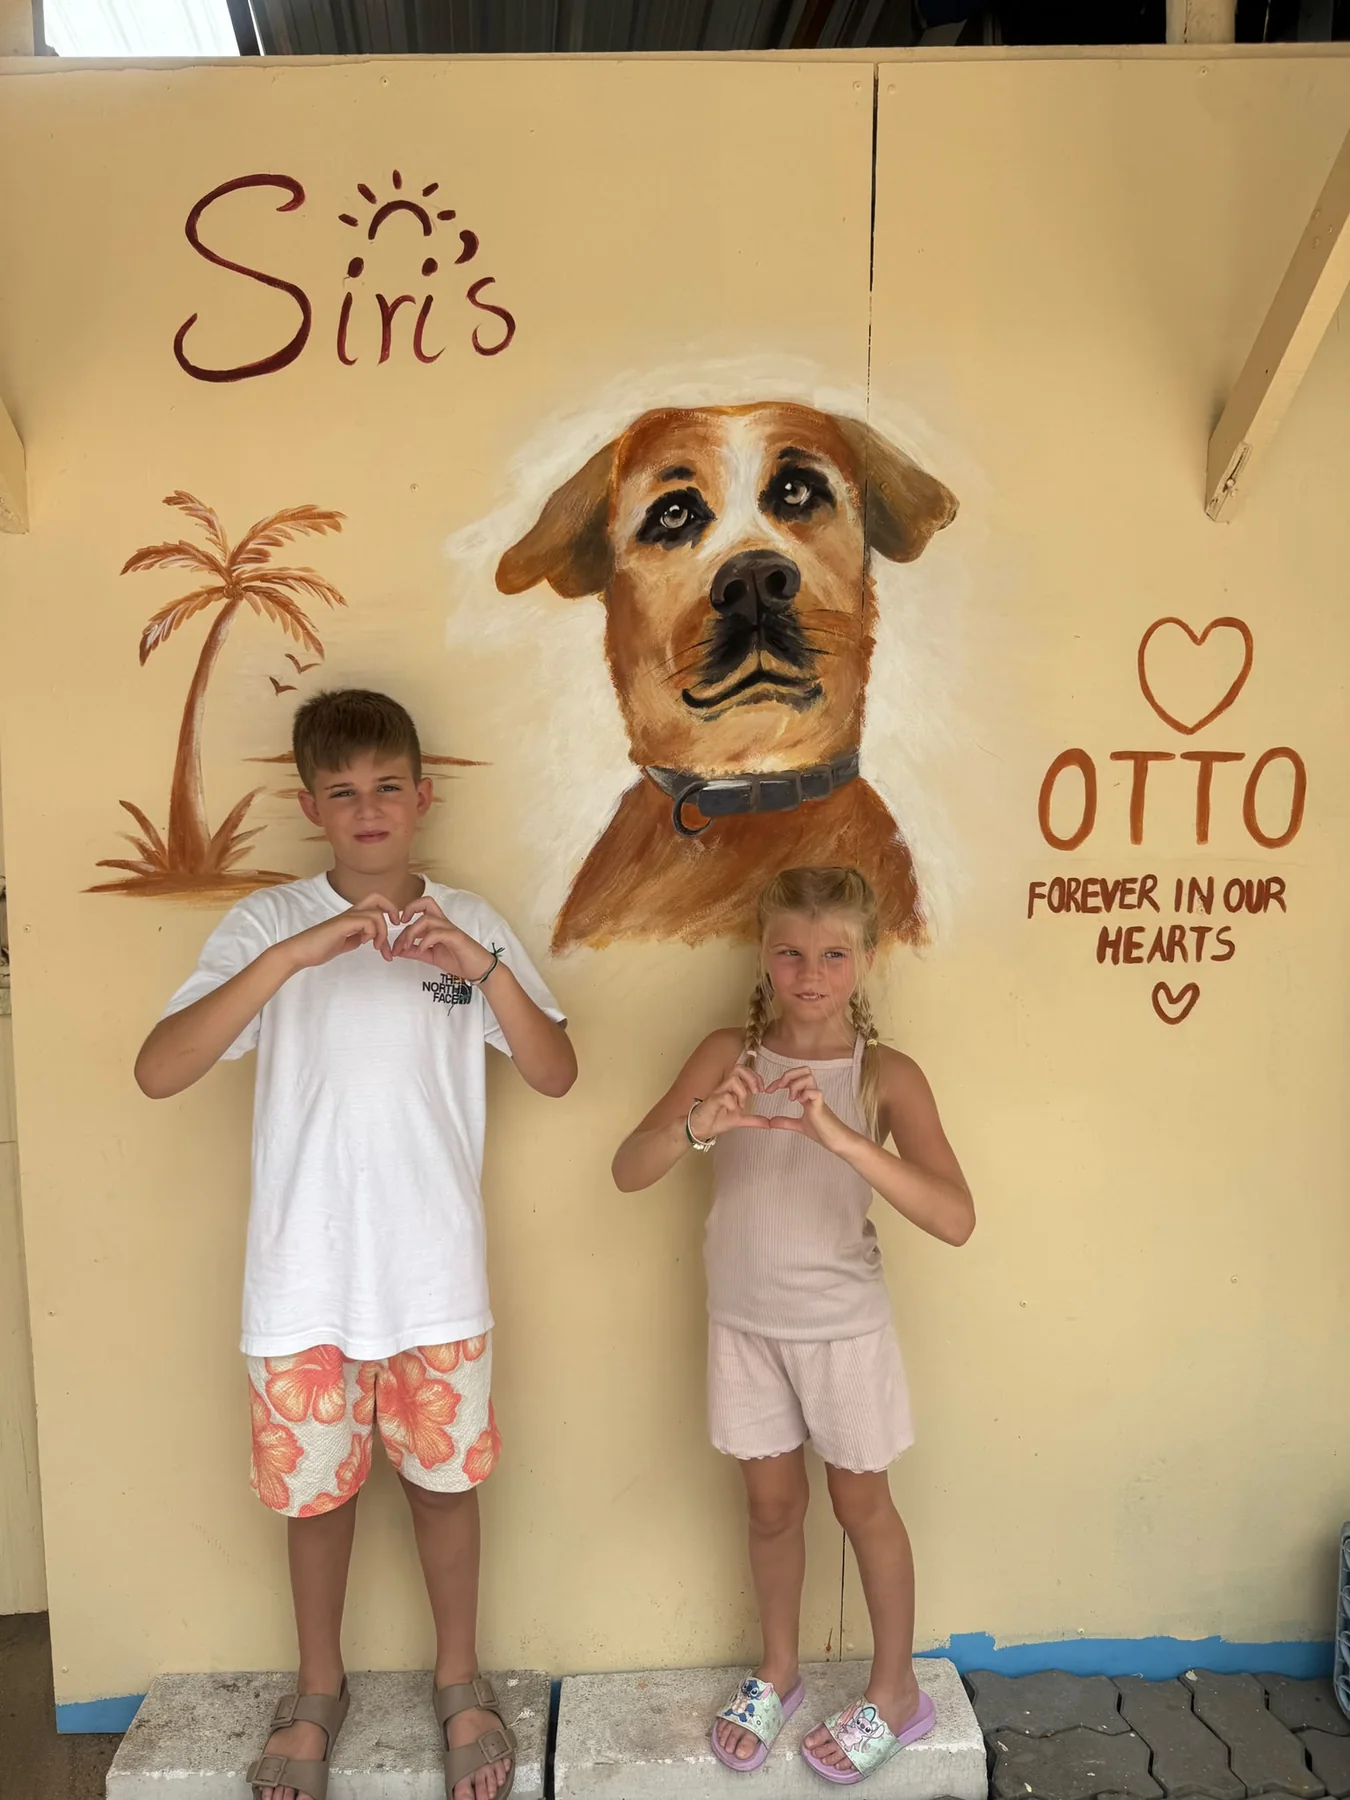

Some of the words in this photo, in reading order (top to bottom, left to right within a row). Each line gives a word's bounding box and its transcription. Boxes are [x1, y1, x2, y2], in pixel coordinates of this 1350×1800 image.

[173, 173, 517, 383] Siri's
[1038, 746, 1307, 851] OTTO
[1027, 873, 1161, 919] FOREVER
[1173, 876, 1215, 915] IN
[1222, 875, 1287, 915] OUR
[1096, 924, 1236, 966] HEARTS
[422, 981, 460, 995] NORTH
[432, 993, 459, 1005] FACE
